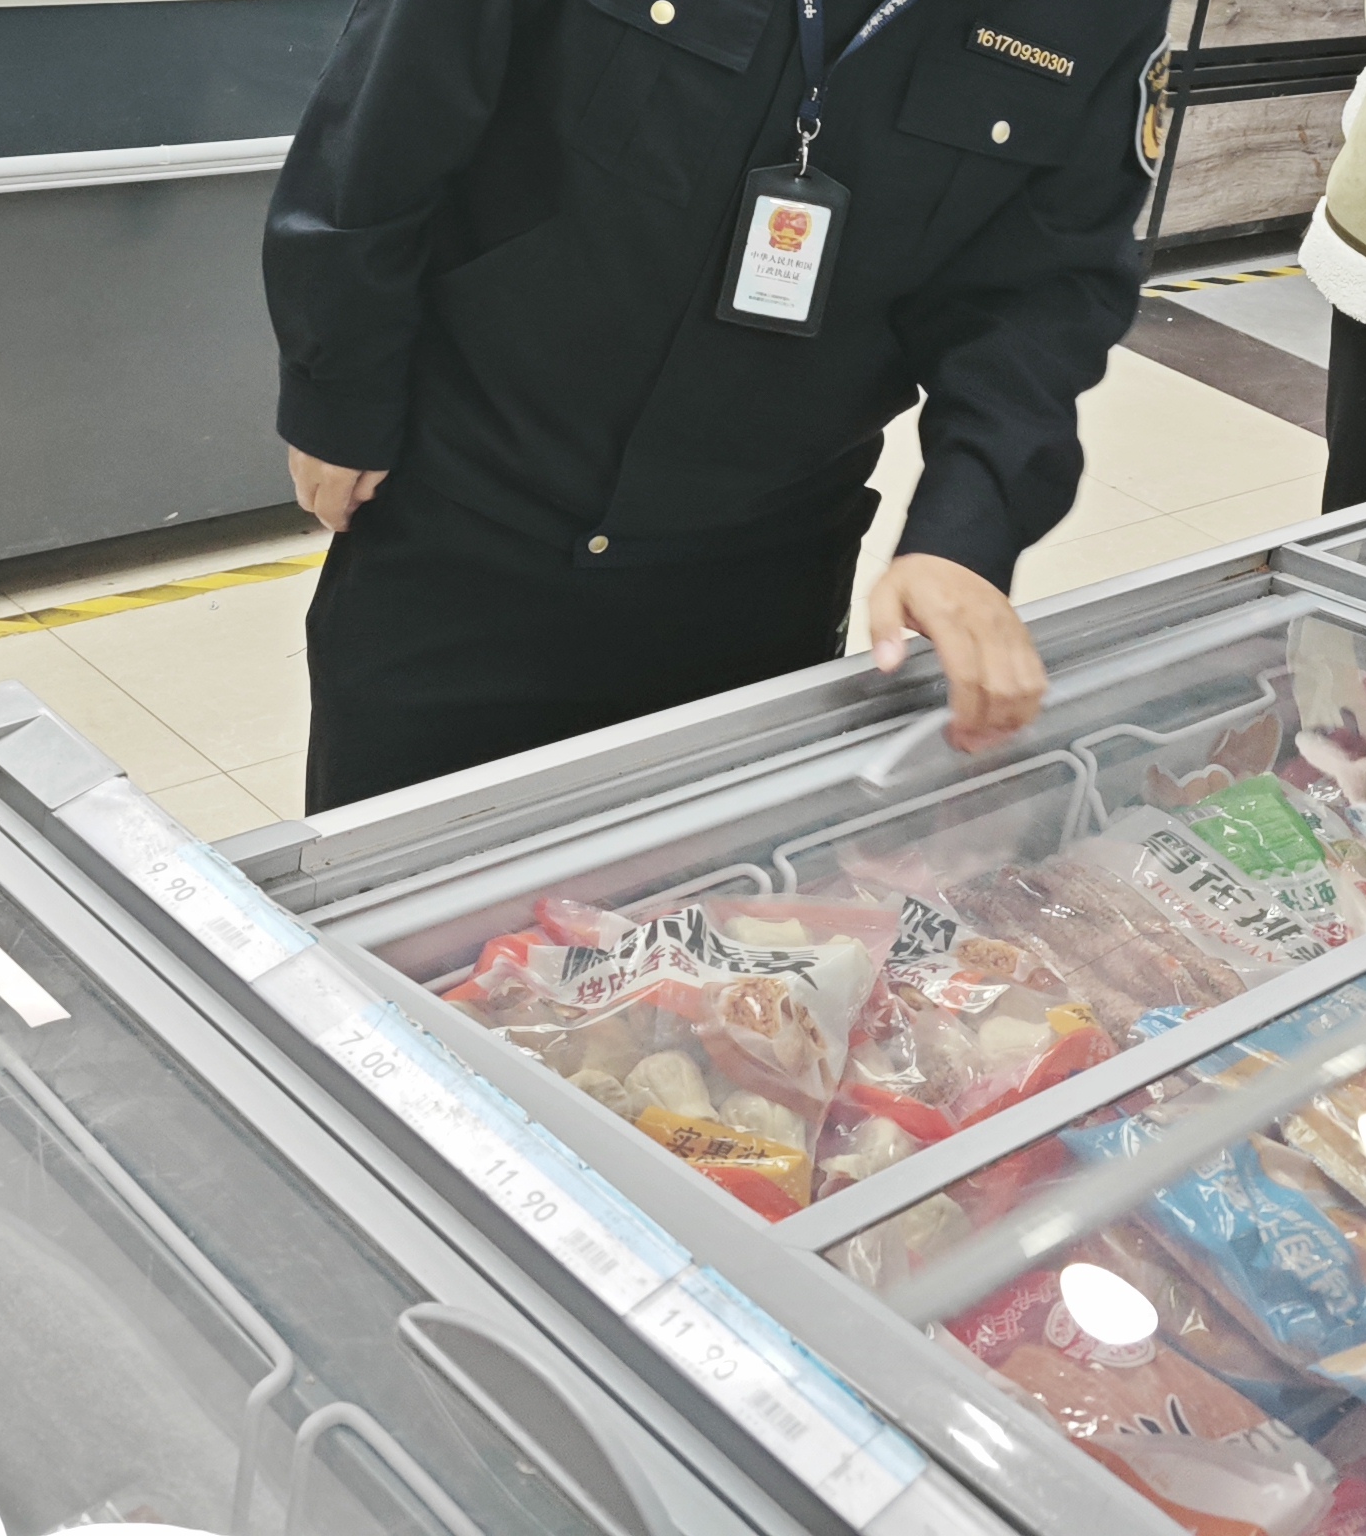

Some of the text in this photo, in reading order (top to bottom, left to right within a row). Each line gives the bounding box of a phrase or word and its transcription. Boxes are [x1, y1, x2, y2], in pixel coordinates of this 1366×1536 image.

[976, 28, 1074, 76] 16170930301
[751, 251, 813, 271] 中华人民共和国
[756, 264, 801, 281] 行政执法证
[144, 860, 197, 902] 9.90
[337, 1030, 396, 1079] 7.00
[484, 1158, 559, 1224] 11.90
[657, 1305, 740, 1383] 11.90
